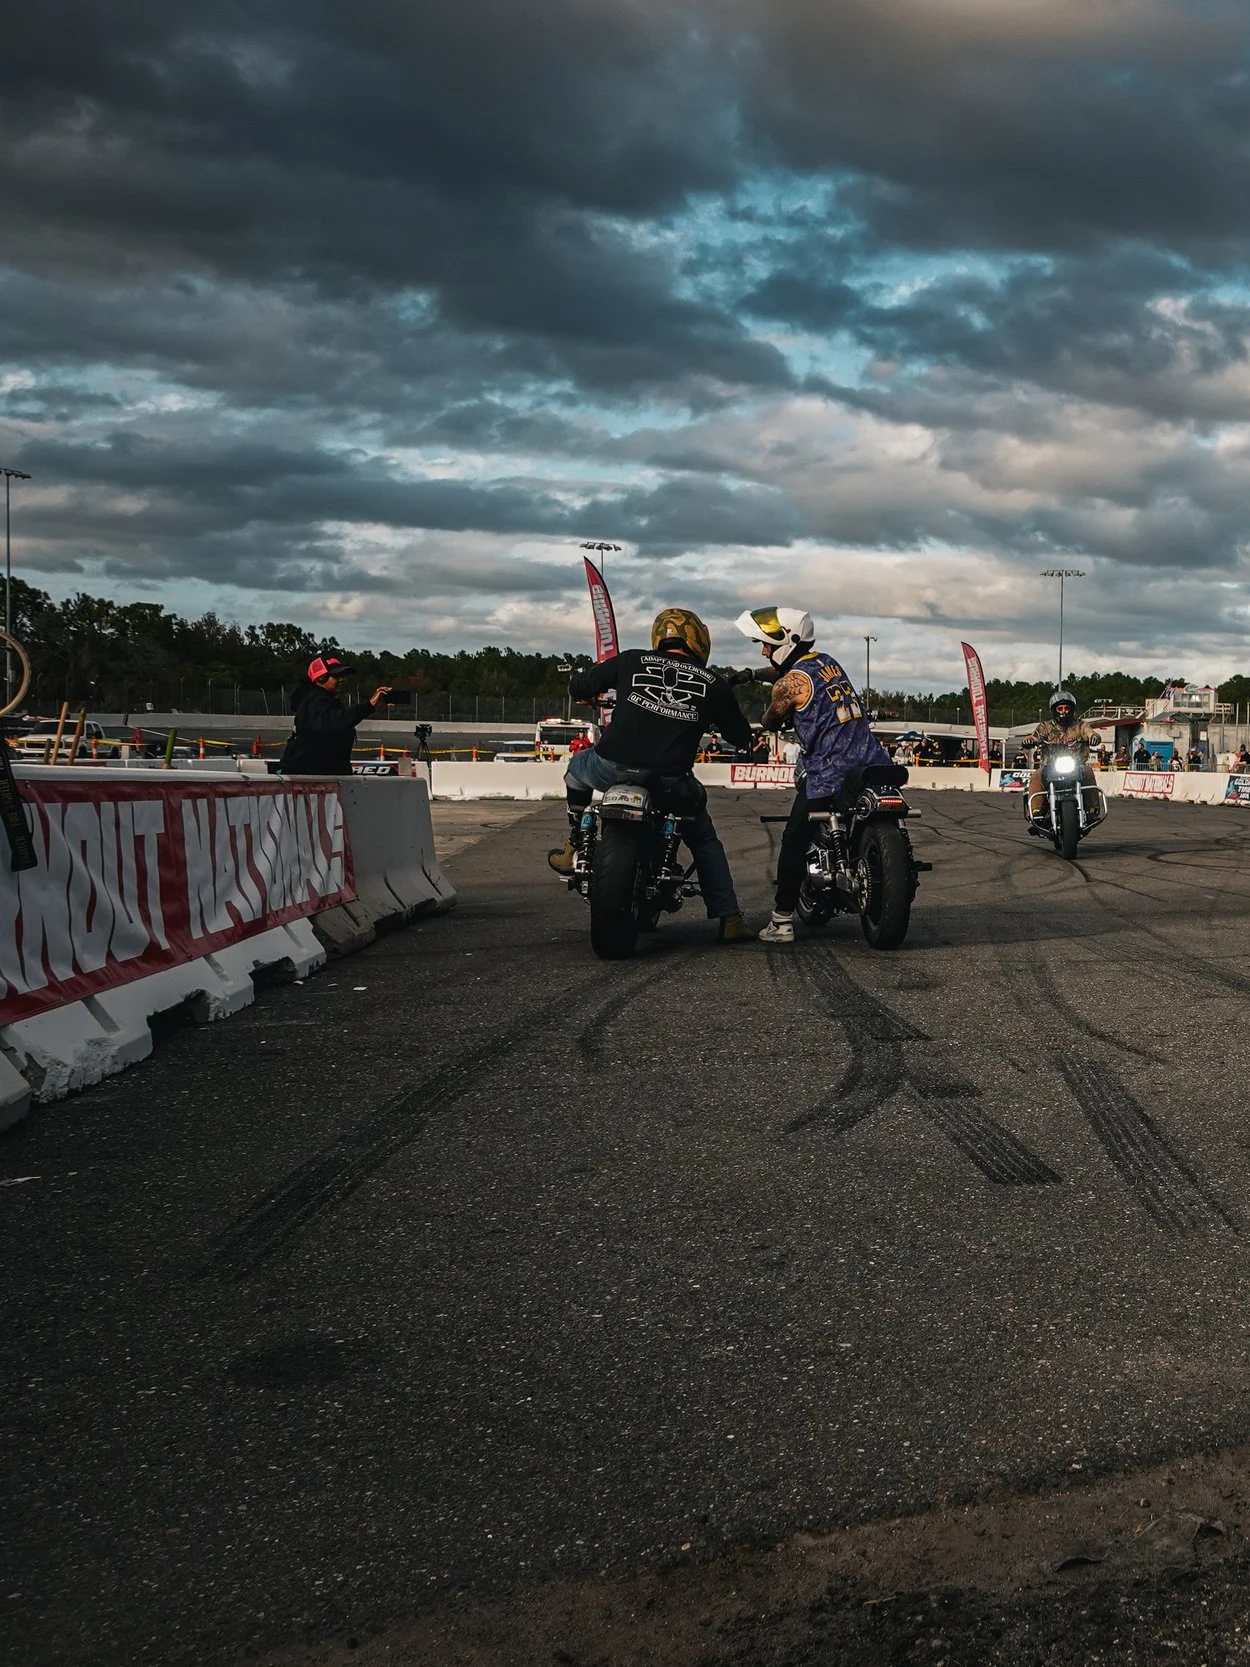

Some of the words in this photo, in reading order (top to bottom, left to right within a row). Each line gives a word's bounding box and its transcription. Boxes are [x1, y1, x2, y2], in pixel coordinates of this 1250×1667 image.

[641, 700, 697, 720] PERFORMANCE
[734, 765, 797, 782] BURNOU
[0, 800, 171, 999] NOUT
